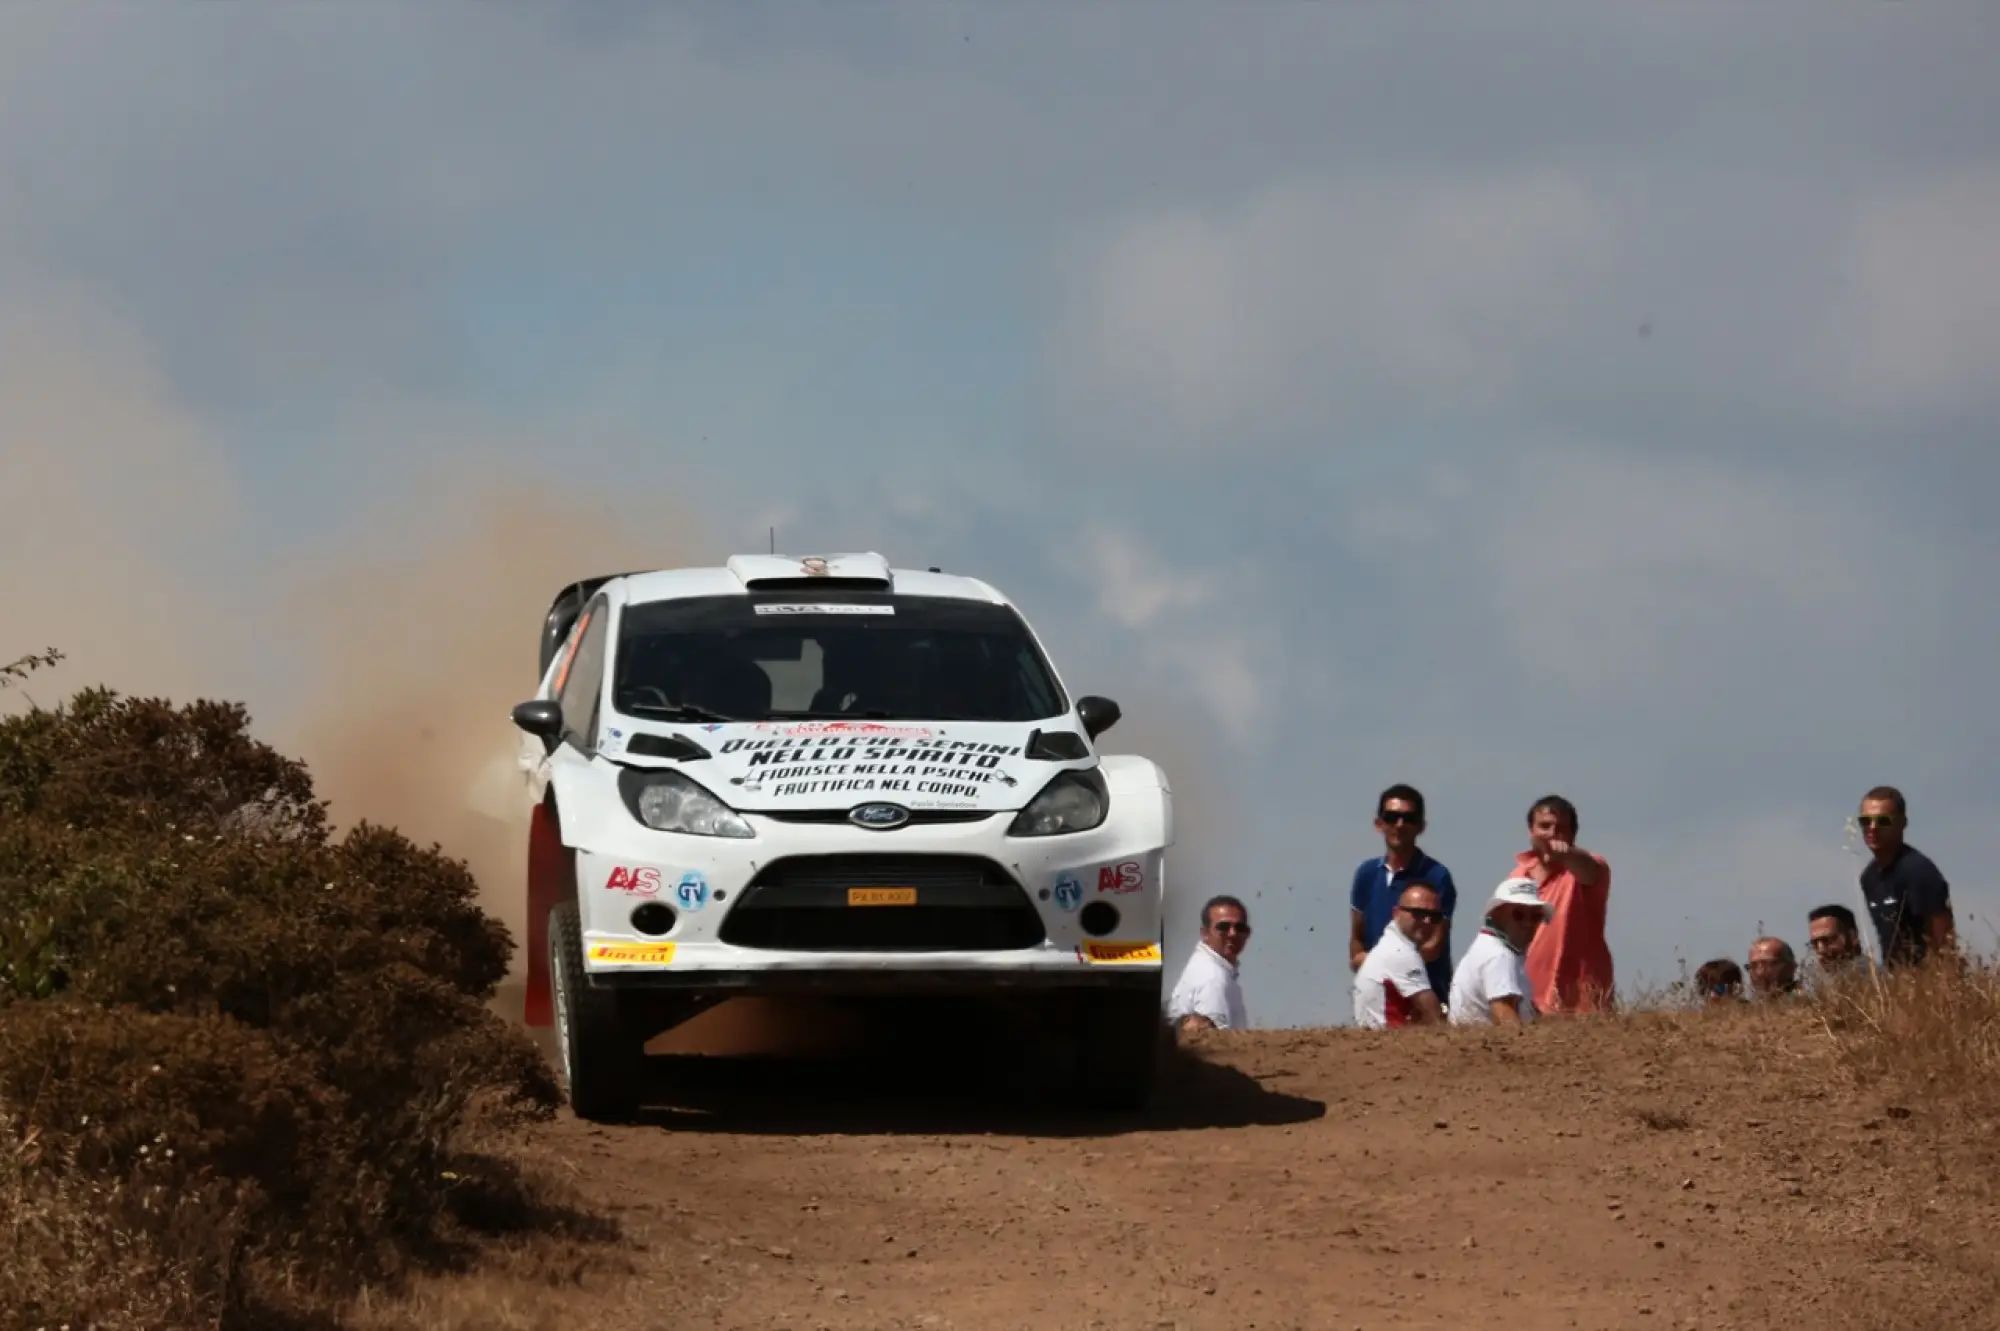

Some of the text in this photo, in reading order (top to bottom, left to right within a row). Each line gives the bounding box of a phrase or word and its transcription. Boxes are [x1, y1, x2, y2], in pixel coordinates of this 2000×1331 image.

[720, 737, 843, 754] QUELLO
[914, 738, 1022, 756] SEMINI
[748, 747, 1001, 768] NELLO SPIRITO
[758, 763, 993, 783] FIORISCE NELLA PSICHE
[774, 779, 875, 796] FRUTTIFICA
[880, 779, 912, 791] NEL
[597, 946, 669, 962] PIRELLI
